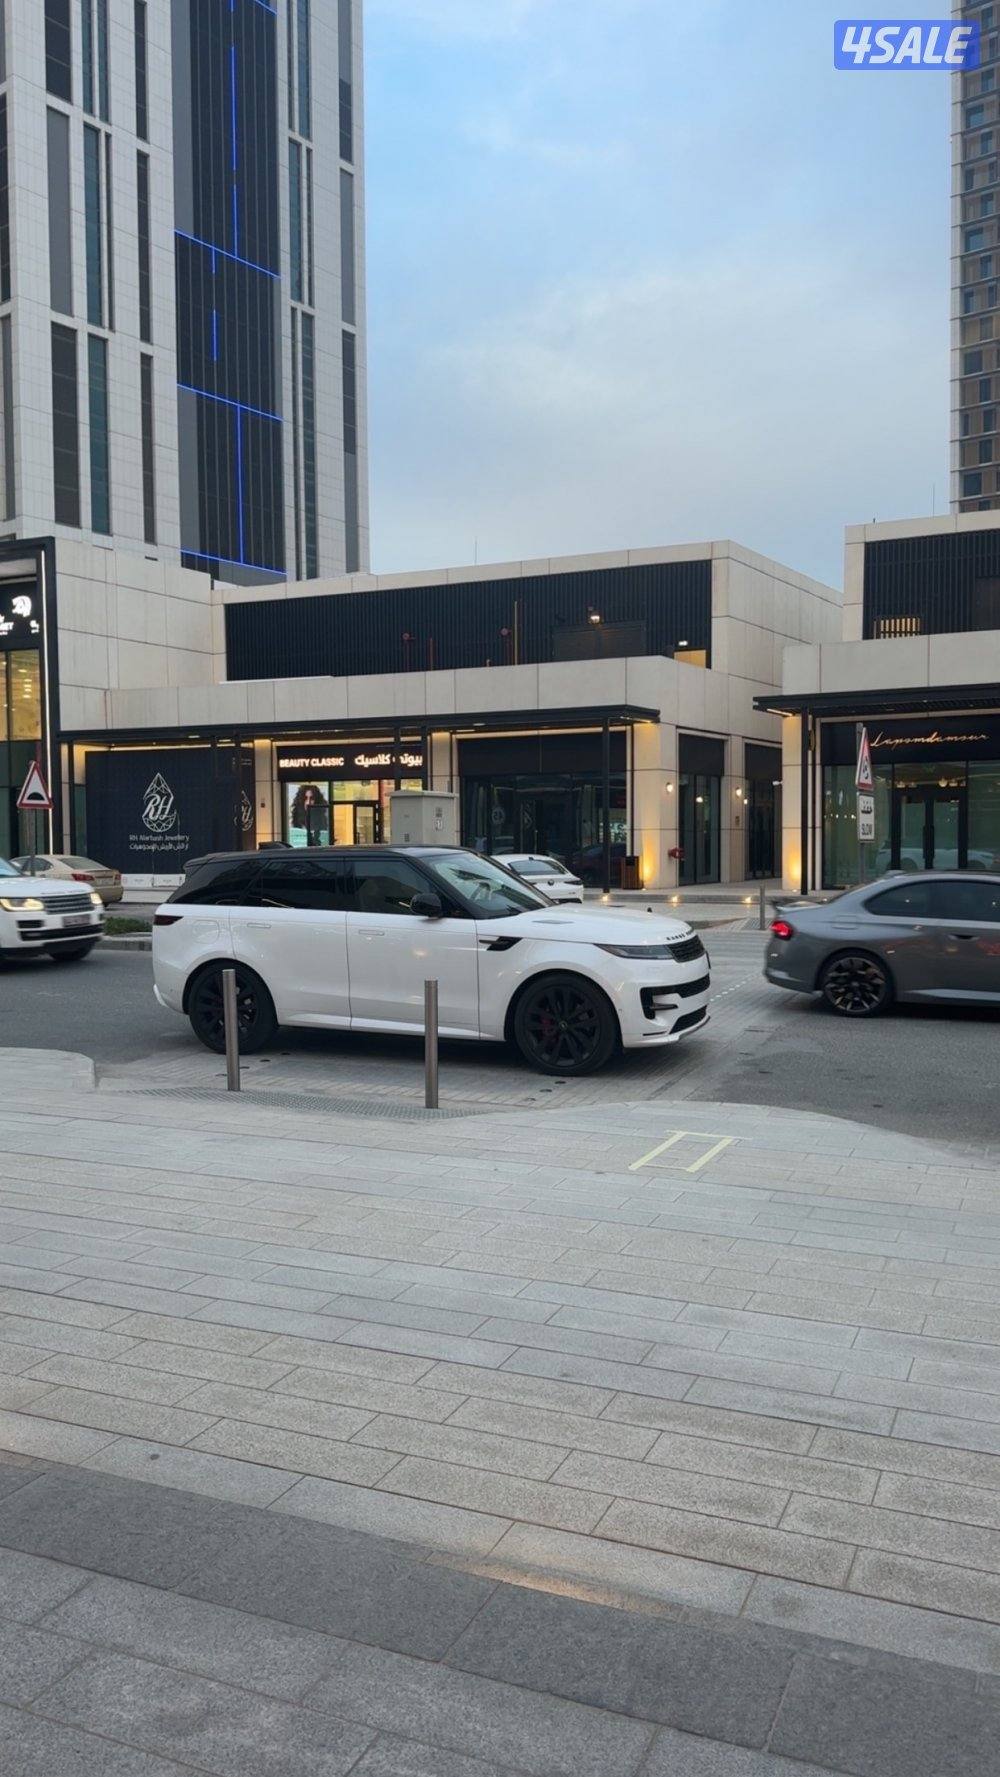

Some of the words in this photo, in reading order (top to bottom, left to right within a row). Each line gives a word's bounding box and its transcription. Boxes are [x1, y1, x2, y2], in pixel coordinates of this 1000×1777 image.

[279, 758, 310, 768] BEAUTY
[311, 757, 344, 767] CLASSIC
[354, 753, 391, 767] كلاسيك
